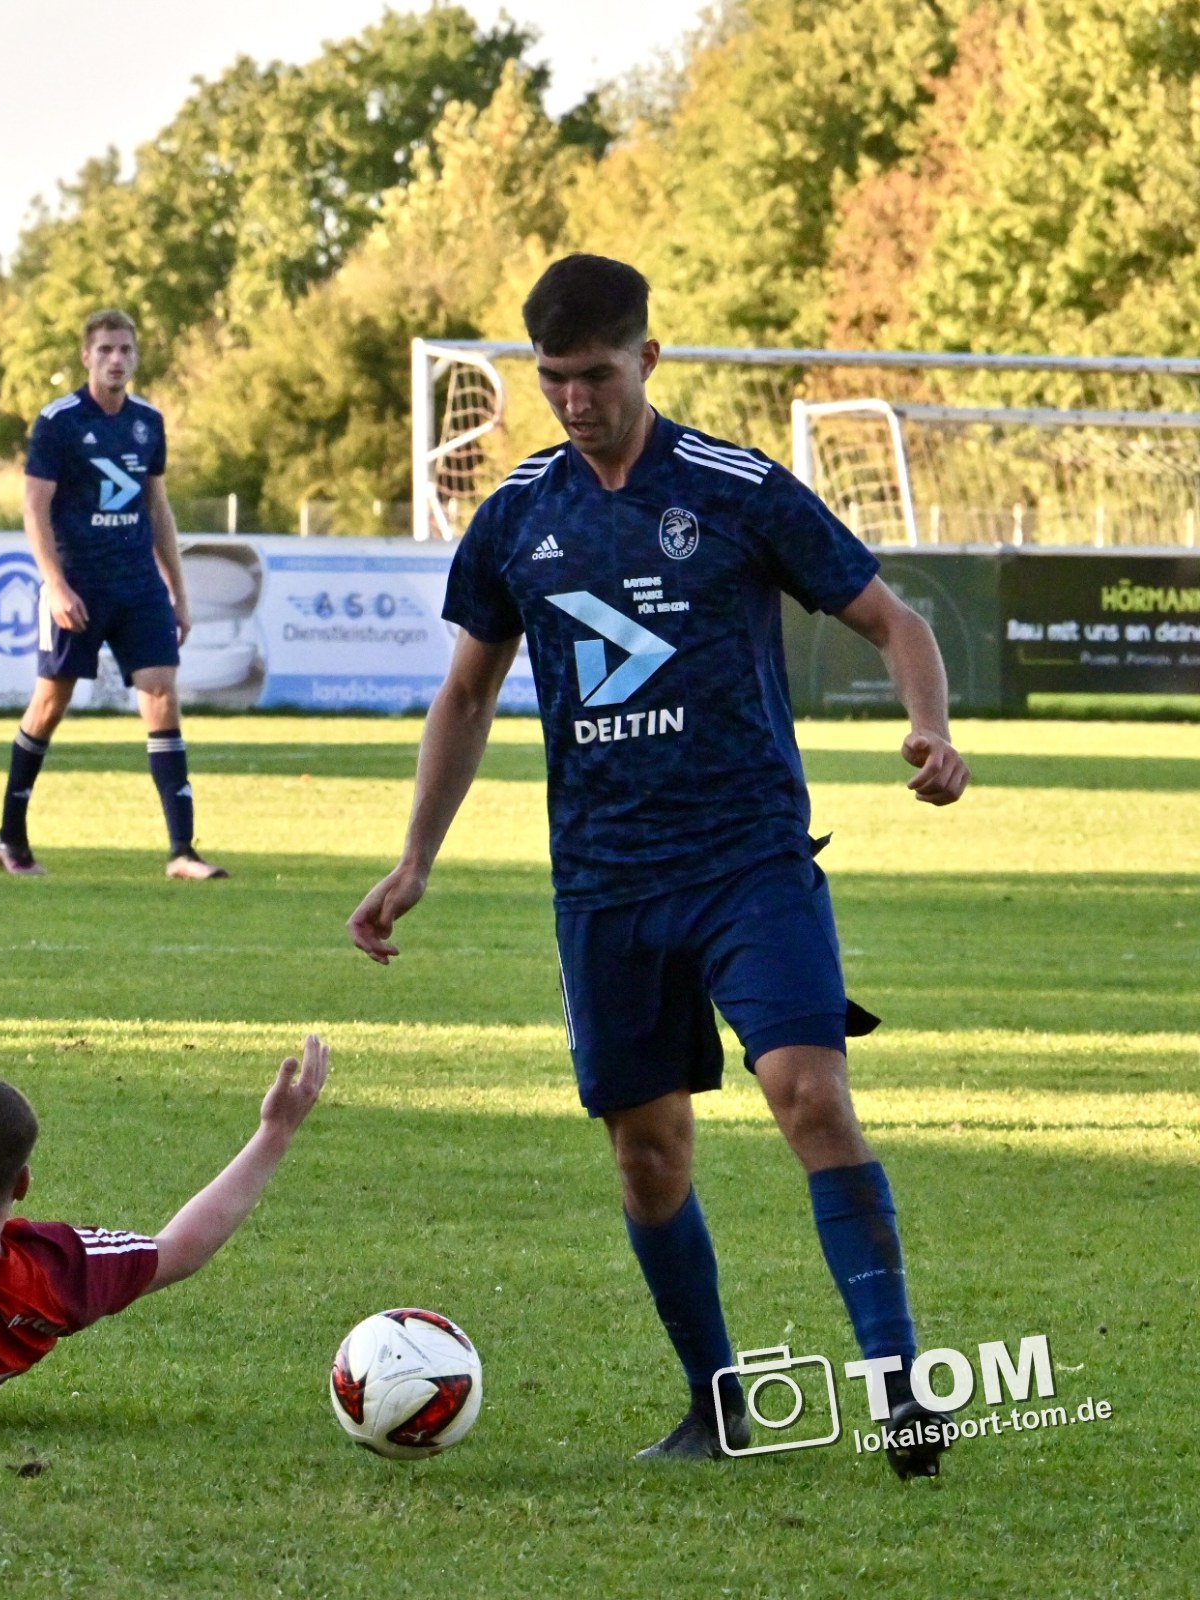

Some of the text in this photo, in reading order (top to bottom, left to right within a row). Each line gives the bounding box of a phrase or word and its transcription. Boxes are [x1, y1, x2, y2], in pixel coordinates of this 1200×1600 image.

[91, 513, 138, 527] DELTIN
[532, 549, 564, 560] adidas
[623, 576, 662, 588] BAYERNS
[633, 590, 663, 601] MARKE
[638, 601, 689, 614] FÜR BENZIN
[283, 623, 428, 645] Dienstleistungen
[1084, 624, 1120, 642] uns
[1124, 624, 1151, 642] an
[574, 706, 684, 744] DELTIN
[848, 1268, 887, 1284] STARK
